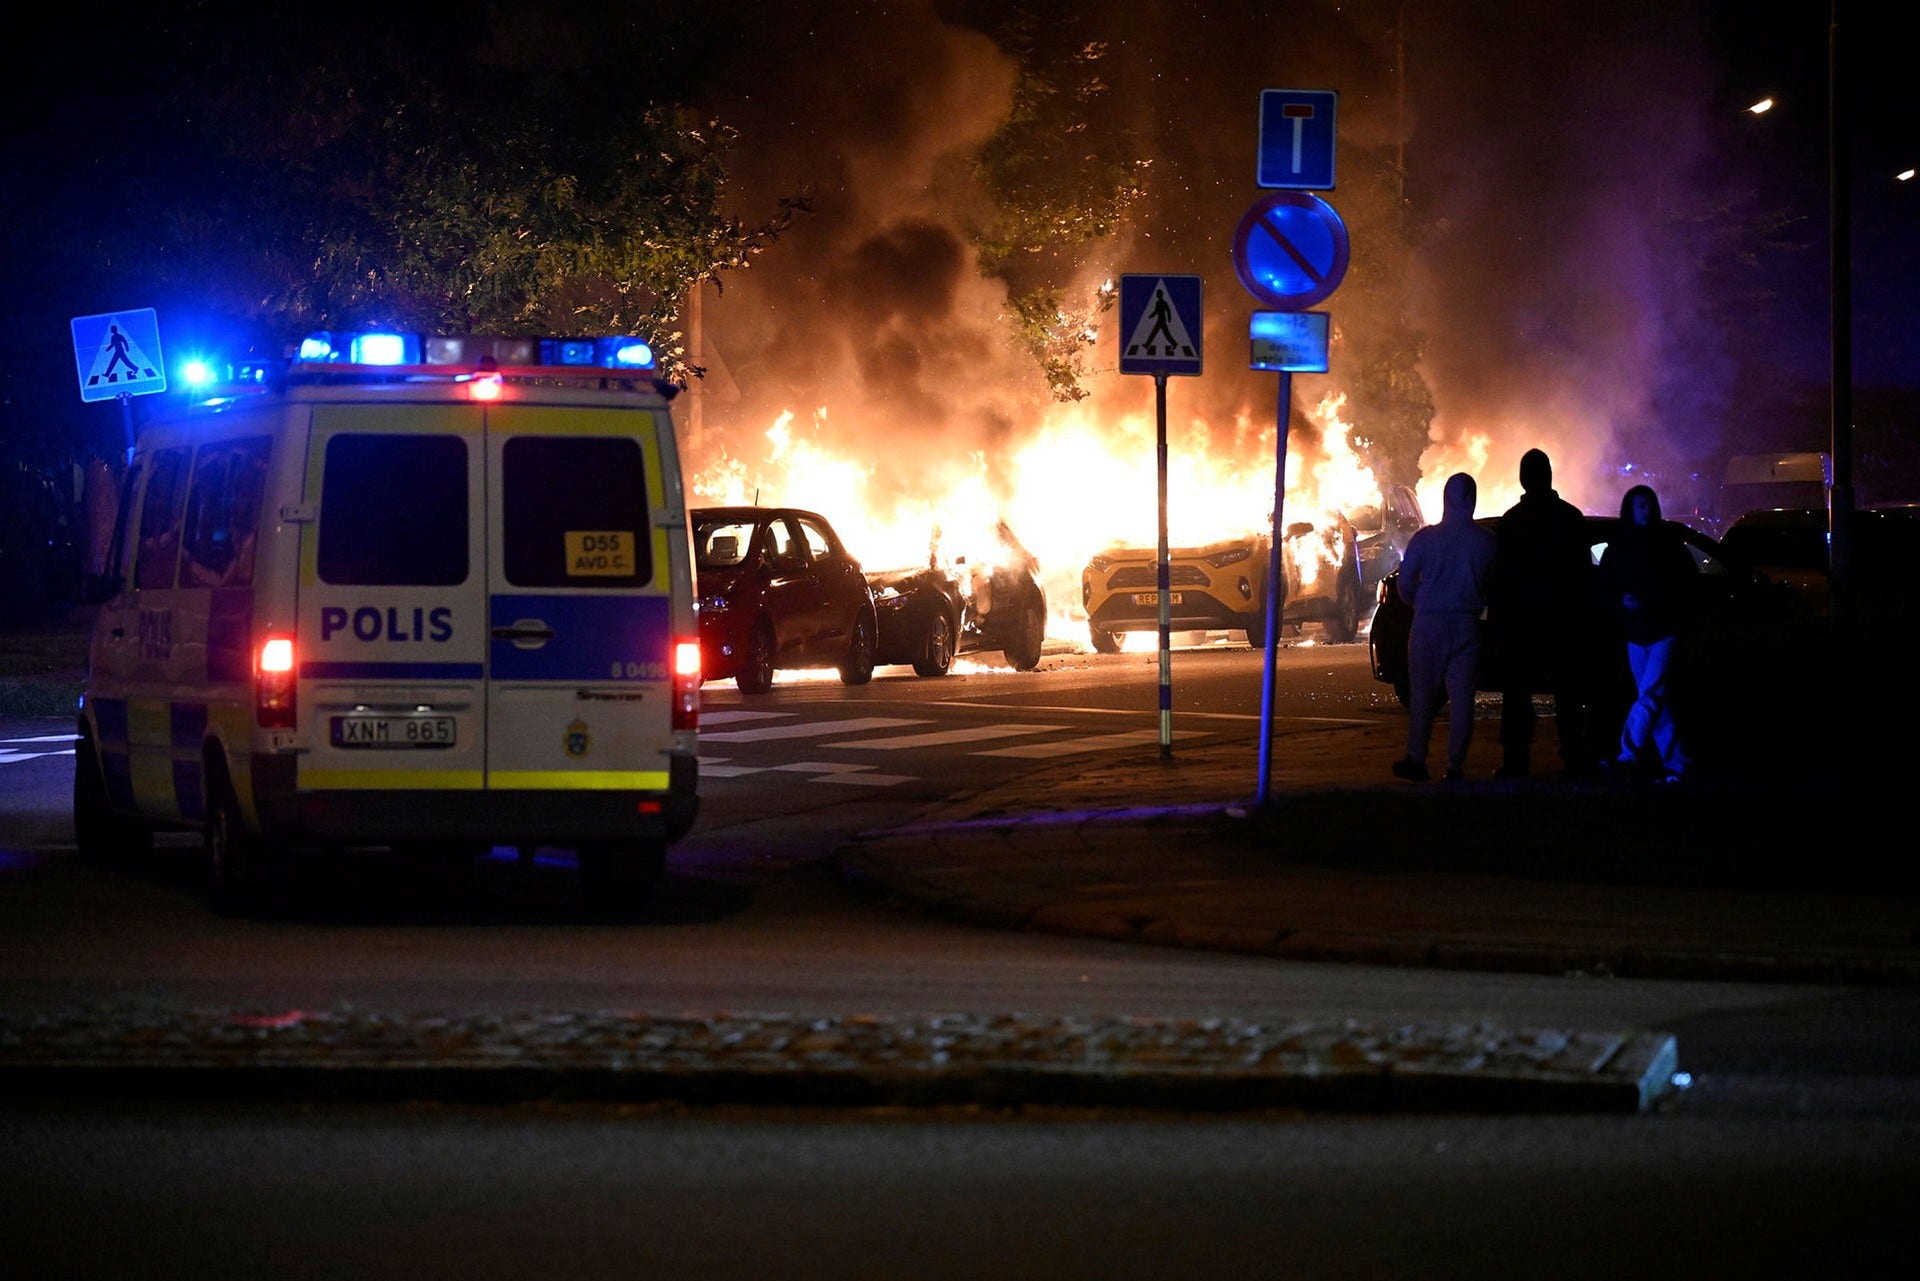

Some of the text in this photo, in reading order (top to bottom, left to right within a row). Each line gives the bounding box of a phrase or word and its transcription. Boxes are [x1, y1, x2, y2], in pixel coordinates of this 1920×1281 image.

[583, 535, 619, 551] D55
[321, 606, 453, 642] POLIS
[346, 721, 449, 741] XNM 865
